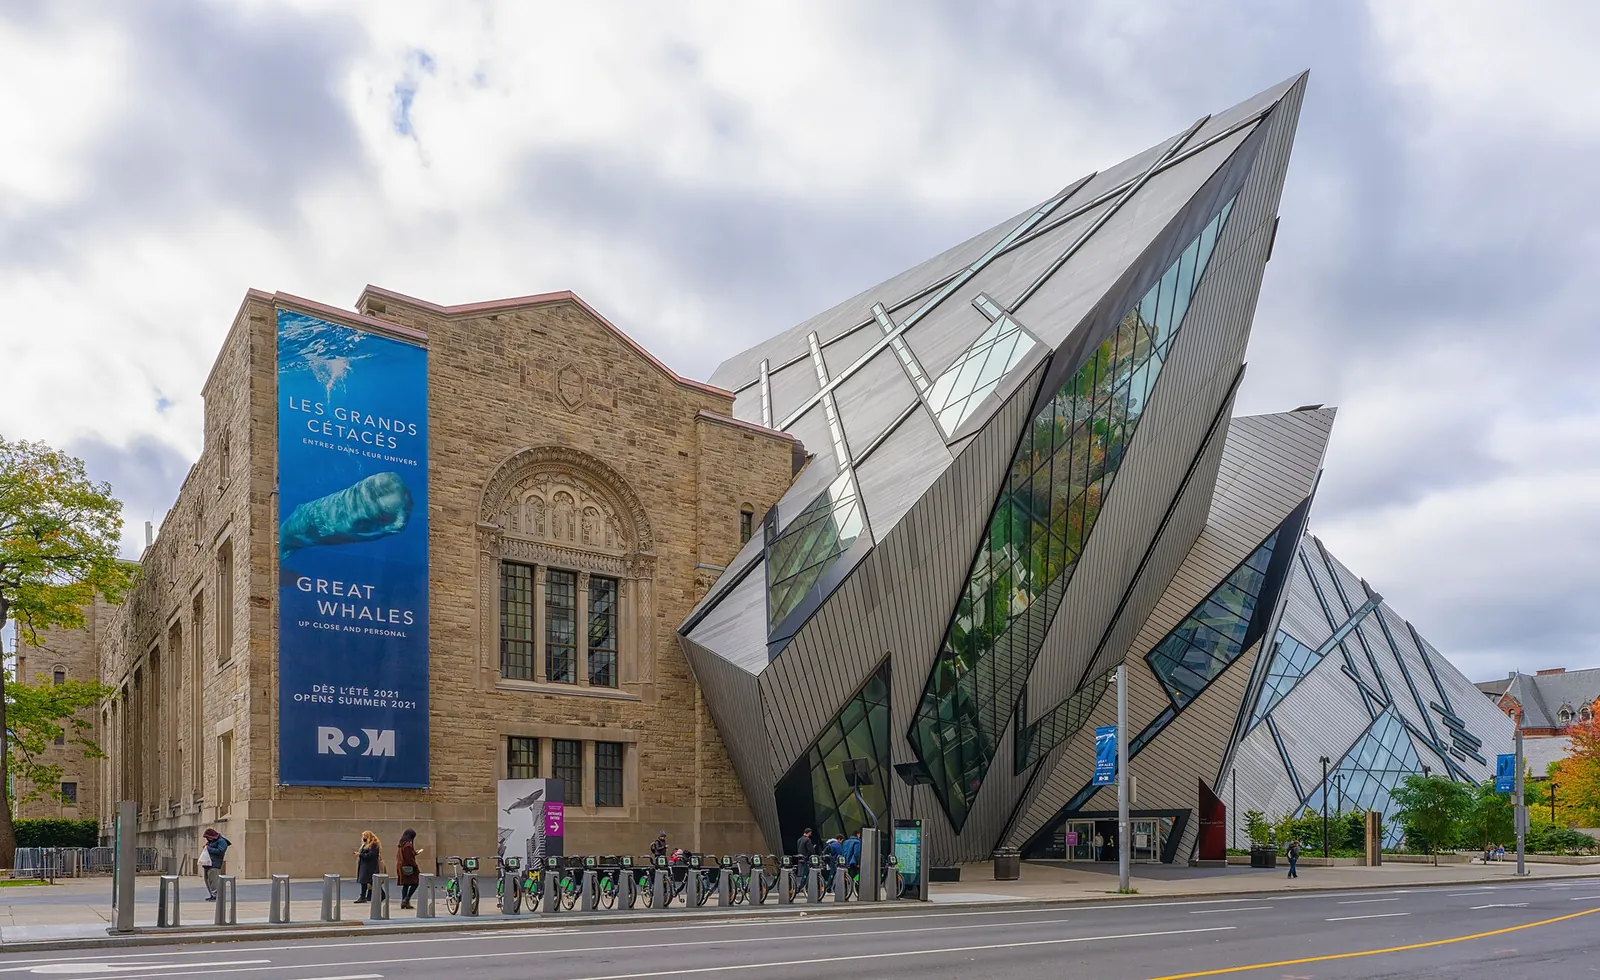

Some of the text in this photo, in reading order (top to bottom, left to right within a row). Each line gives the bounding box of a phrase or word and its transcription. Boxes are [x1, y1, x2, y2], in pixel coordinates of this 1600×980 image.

[289, 396, 417, 436] LES GRANDS
[307, 420, 397, 449] CÉTACÉS
[302, 437, 417, 466] ENTREZ DANS LEUR UNIVERS
[296, 576, 375, 600] GREAT
[317, 600, 414, 625] WHALES
[298, 620, 407, 638] UP CLOSE AND PERSONAL
[293, 693, 416, 709] OPENS SUMMER 2021
[313, 684, 399, 699] DÈS L'ÉTÉ 2021
